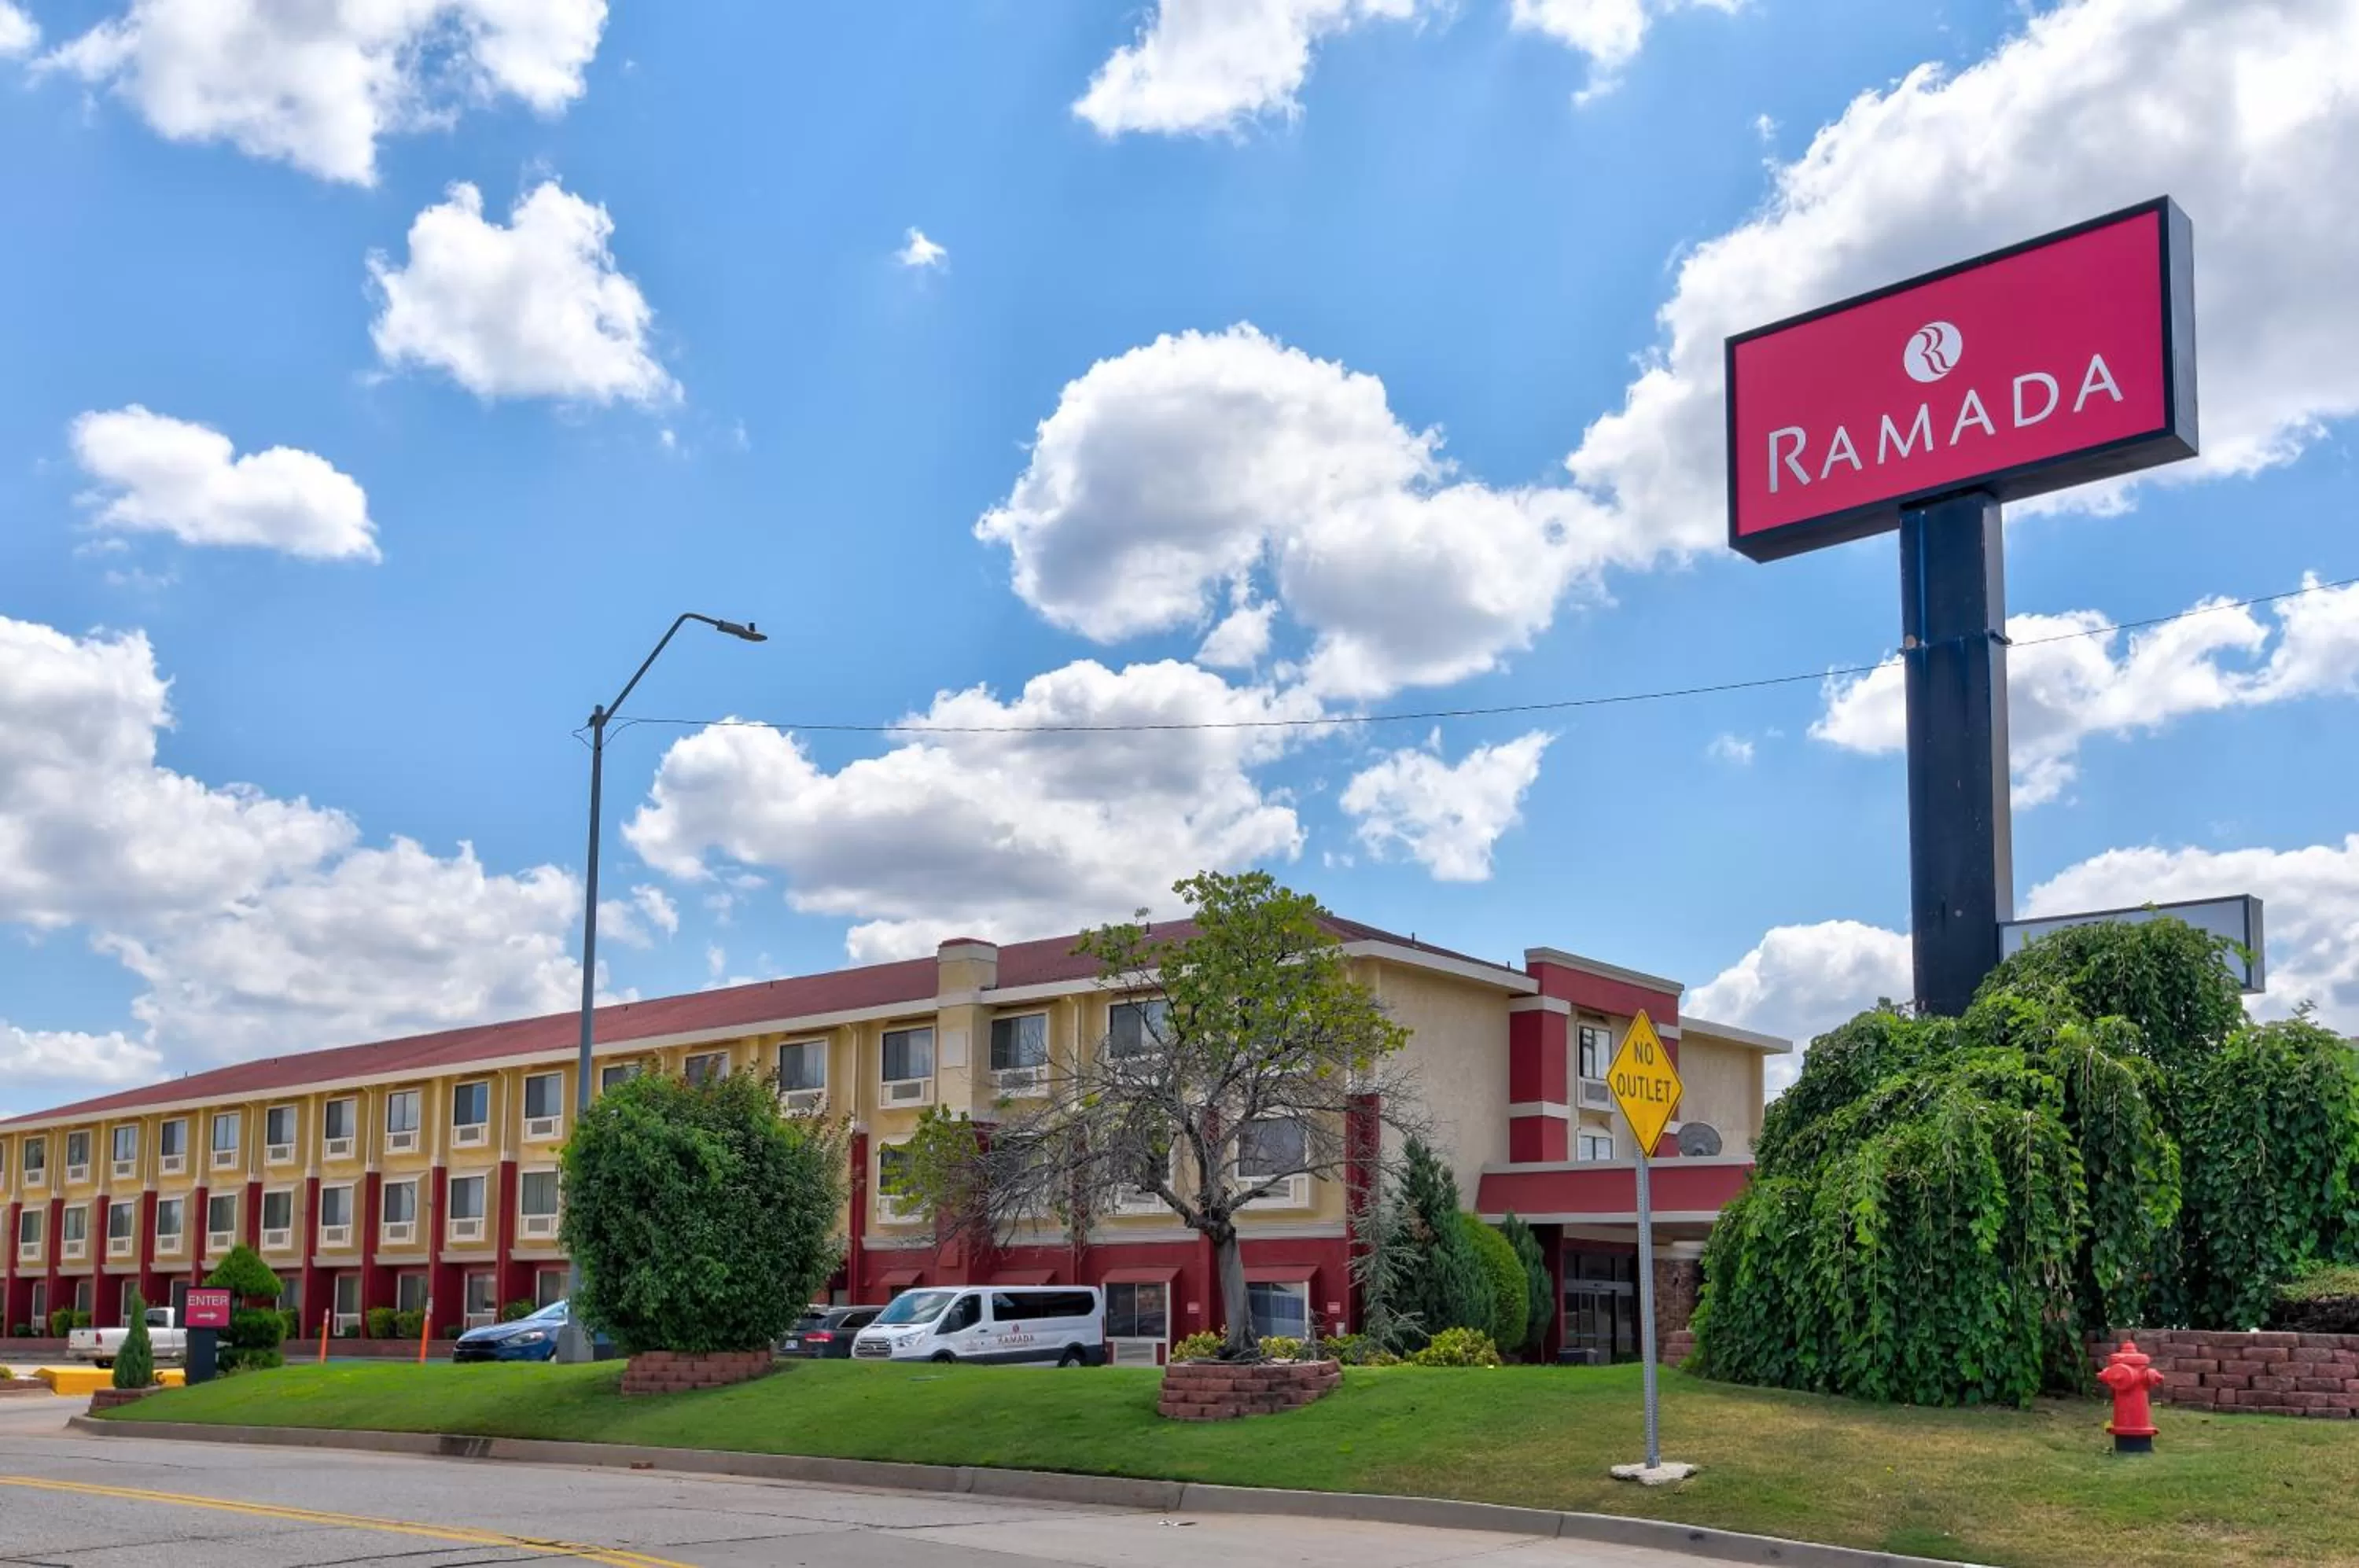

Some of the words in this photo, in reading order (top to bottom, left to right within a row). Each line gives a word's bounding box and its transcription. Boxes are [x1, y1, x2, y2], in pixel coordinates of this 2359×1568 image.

[1768, 352, 2122, 493] RAMADA
[1635, 1041, 1654, 1066] NO
[1616, 1073, 1671, 1103] OUTLET
[189, 1295, 227, 1306] ENTER
